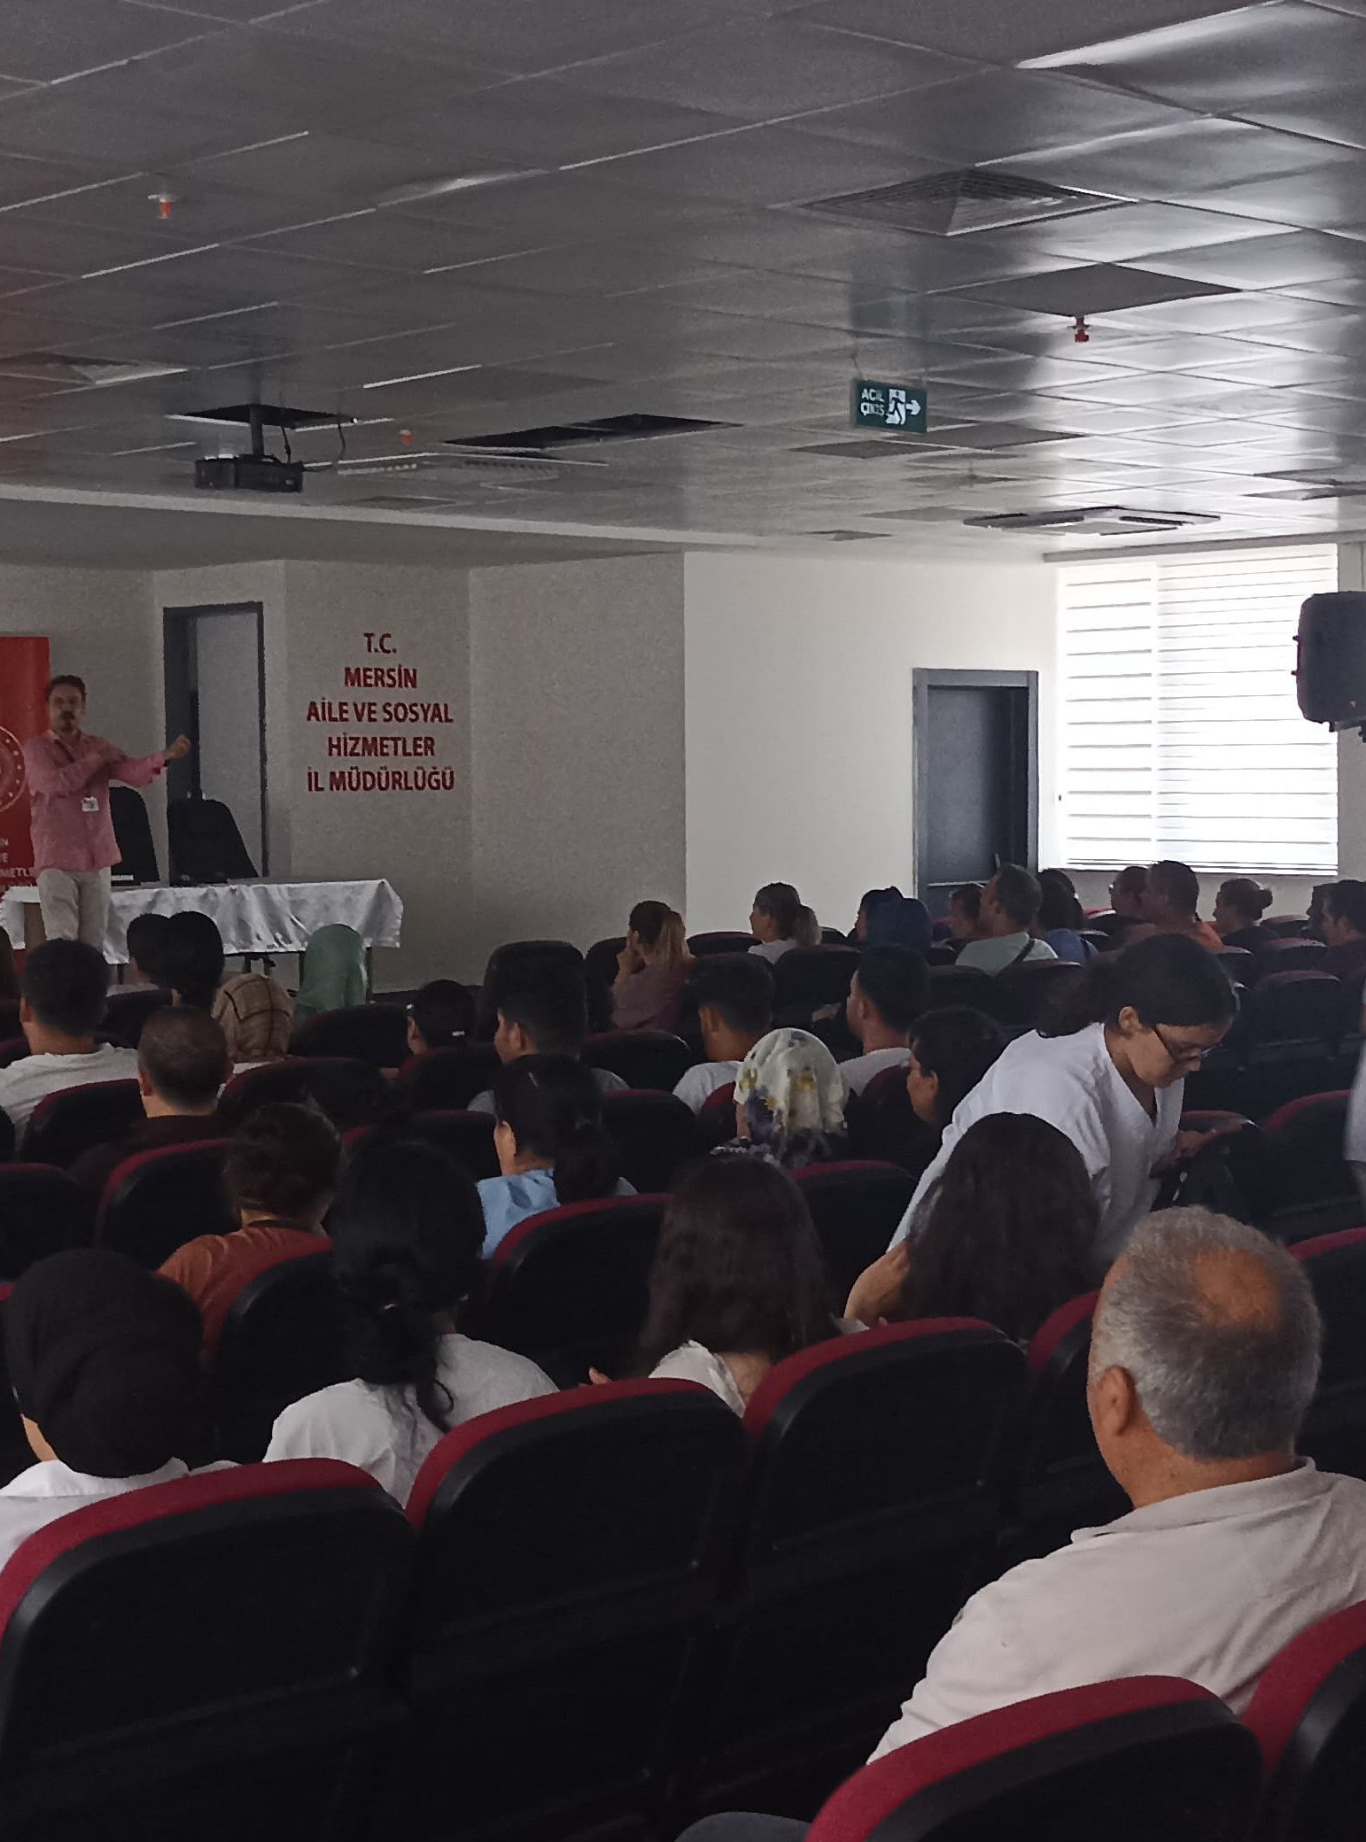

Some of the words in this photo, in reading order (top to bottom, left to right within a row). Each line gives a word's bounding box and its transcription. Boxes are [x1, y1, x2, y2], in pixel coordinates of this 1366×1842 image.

[363, 632, 397, 654] T.C.
[344, 664, 417, 688] MERSİN
[306, 697, 349, 722] AİLE
[353, 702, 377, 722] VE
[382, 702, 454, 723] SOSYAL
[327, 732, 435, 757] HİZMETLER
[307, 766, 324, 792] İL
[329, 765, 455, 792] MÜDÜRLÜĞÜ
